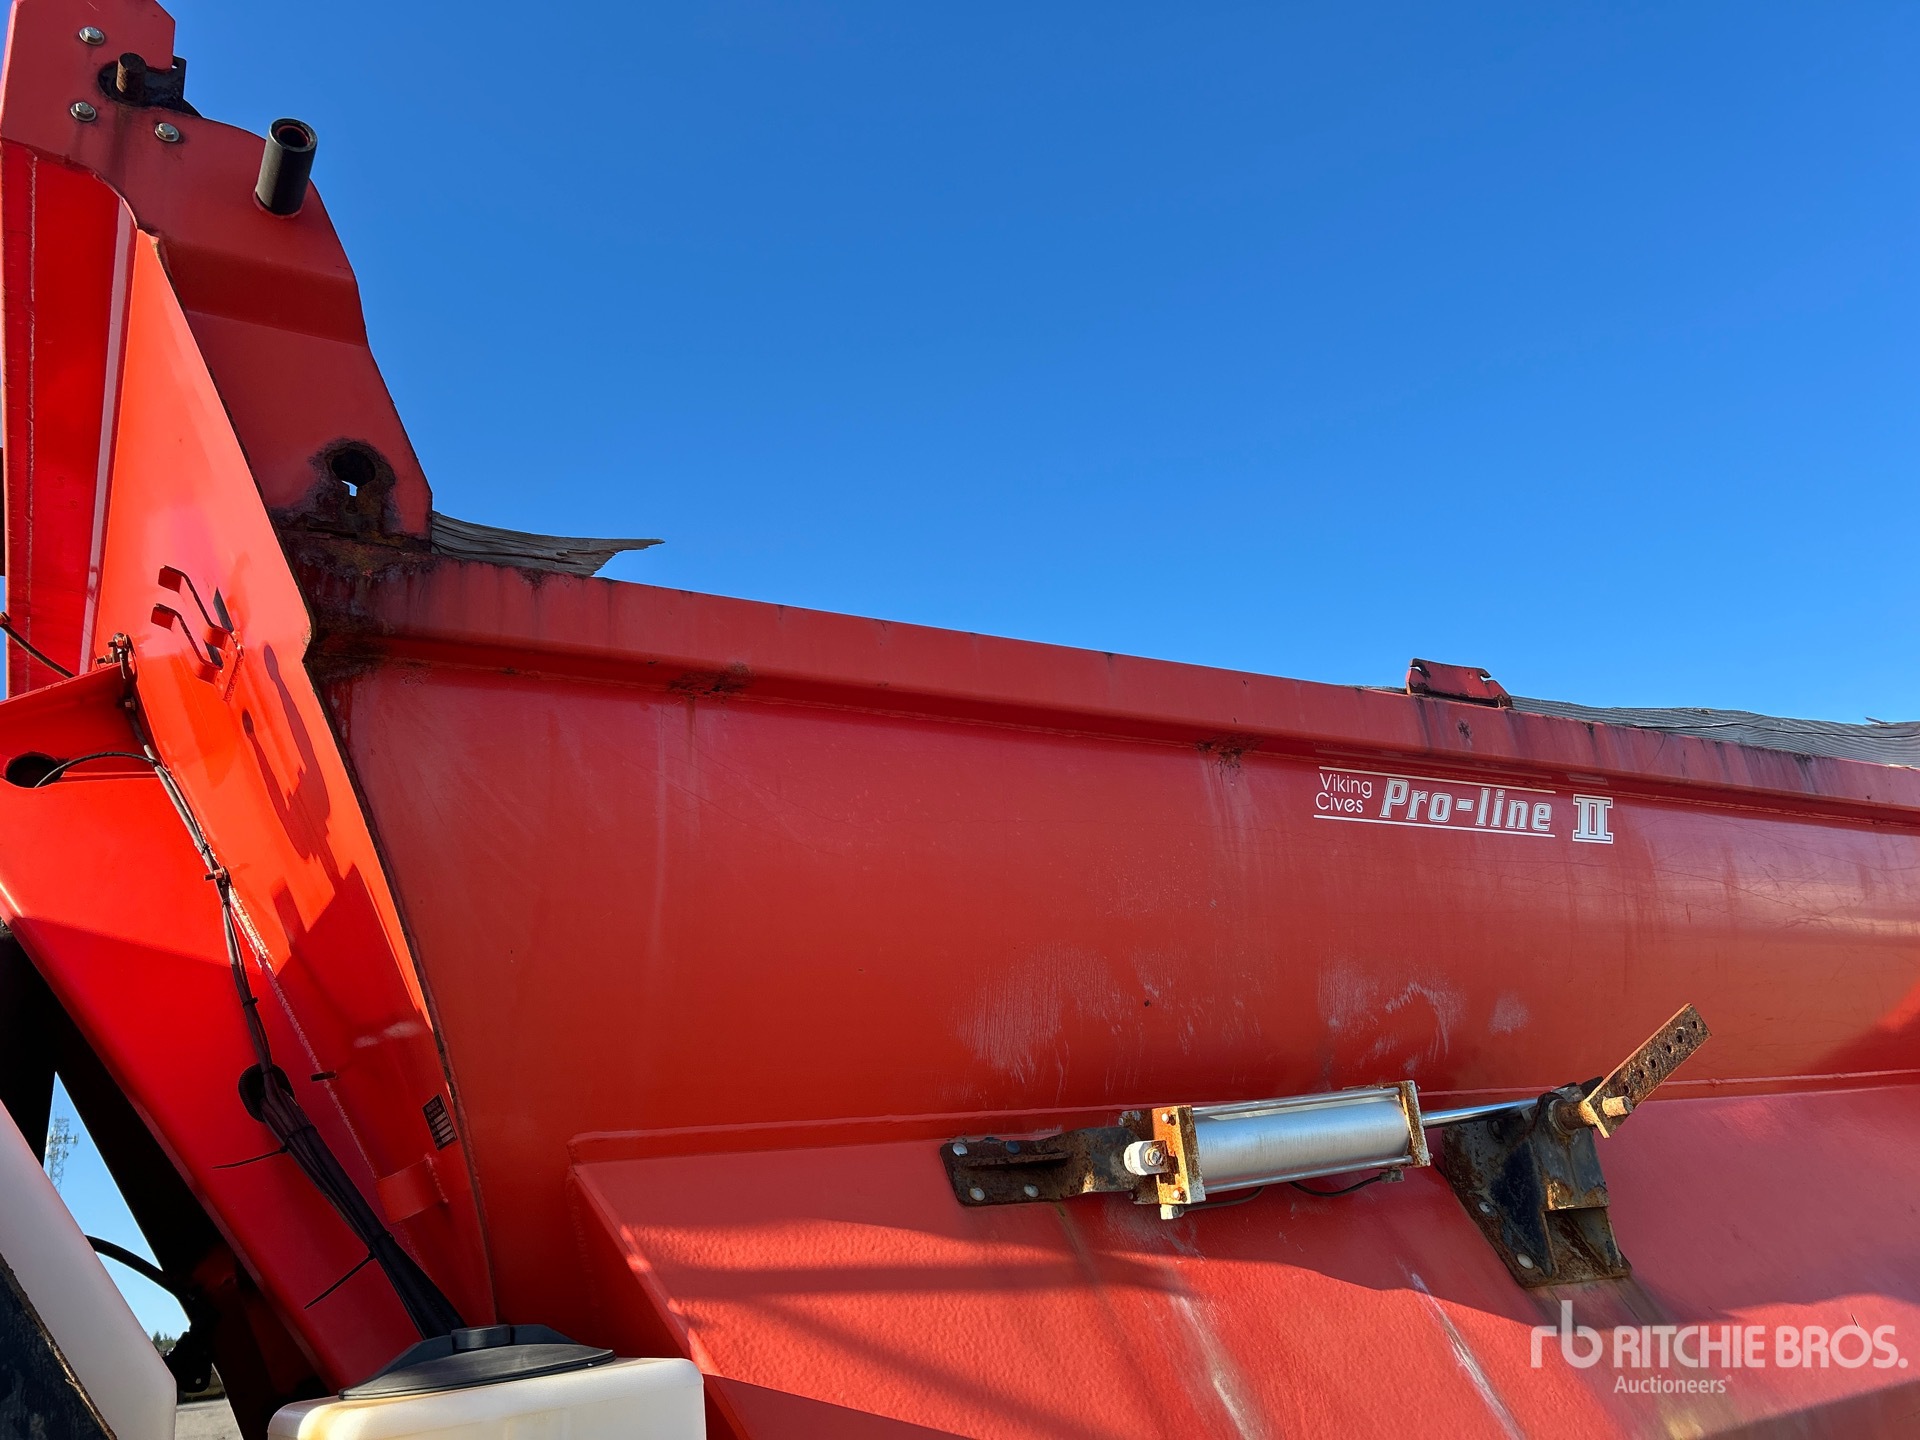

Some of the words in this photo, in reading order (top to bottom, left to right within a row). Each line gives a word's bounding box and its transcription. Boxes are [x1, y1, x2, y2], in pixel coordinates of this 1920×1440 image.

[1319, 773, 1373, 799] Viking
[1315, 792, 1364, 814] Cives
[1379, 777, 1552, 832] Pro-line
[1572, 793, 1614, 844] II
